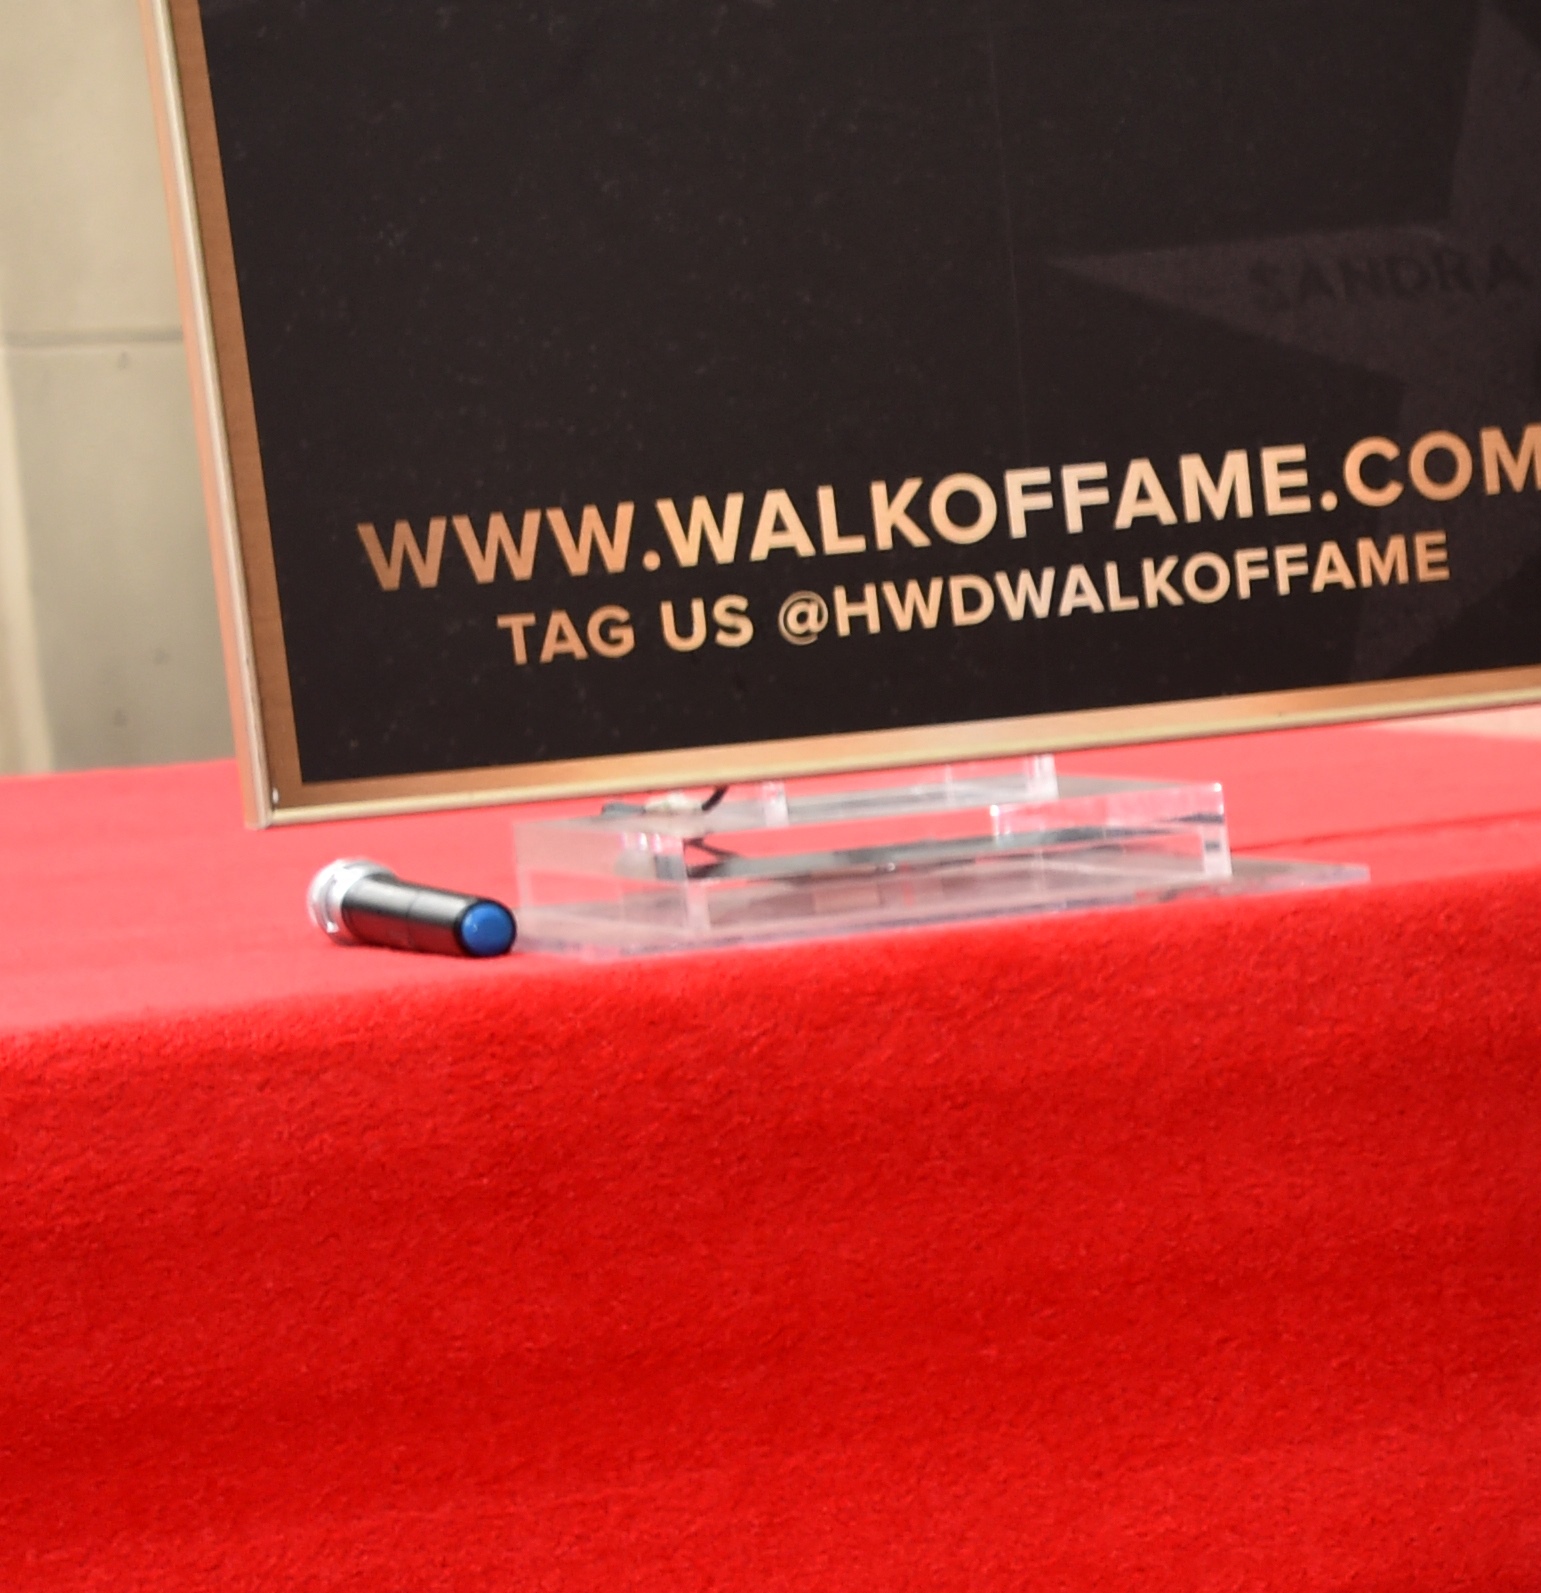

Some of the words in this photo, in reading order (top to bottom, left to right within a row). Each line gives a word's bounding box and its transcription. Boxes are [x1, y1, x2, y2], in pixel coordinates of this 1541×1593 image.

[1247, 243, 1533, 314] SANDRA
[497, 604, 636, 665] TAG
[660, 594, 755, 652] US
[778, 530, 1451, 646] @HWDWALKOFFAME
